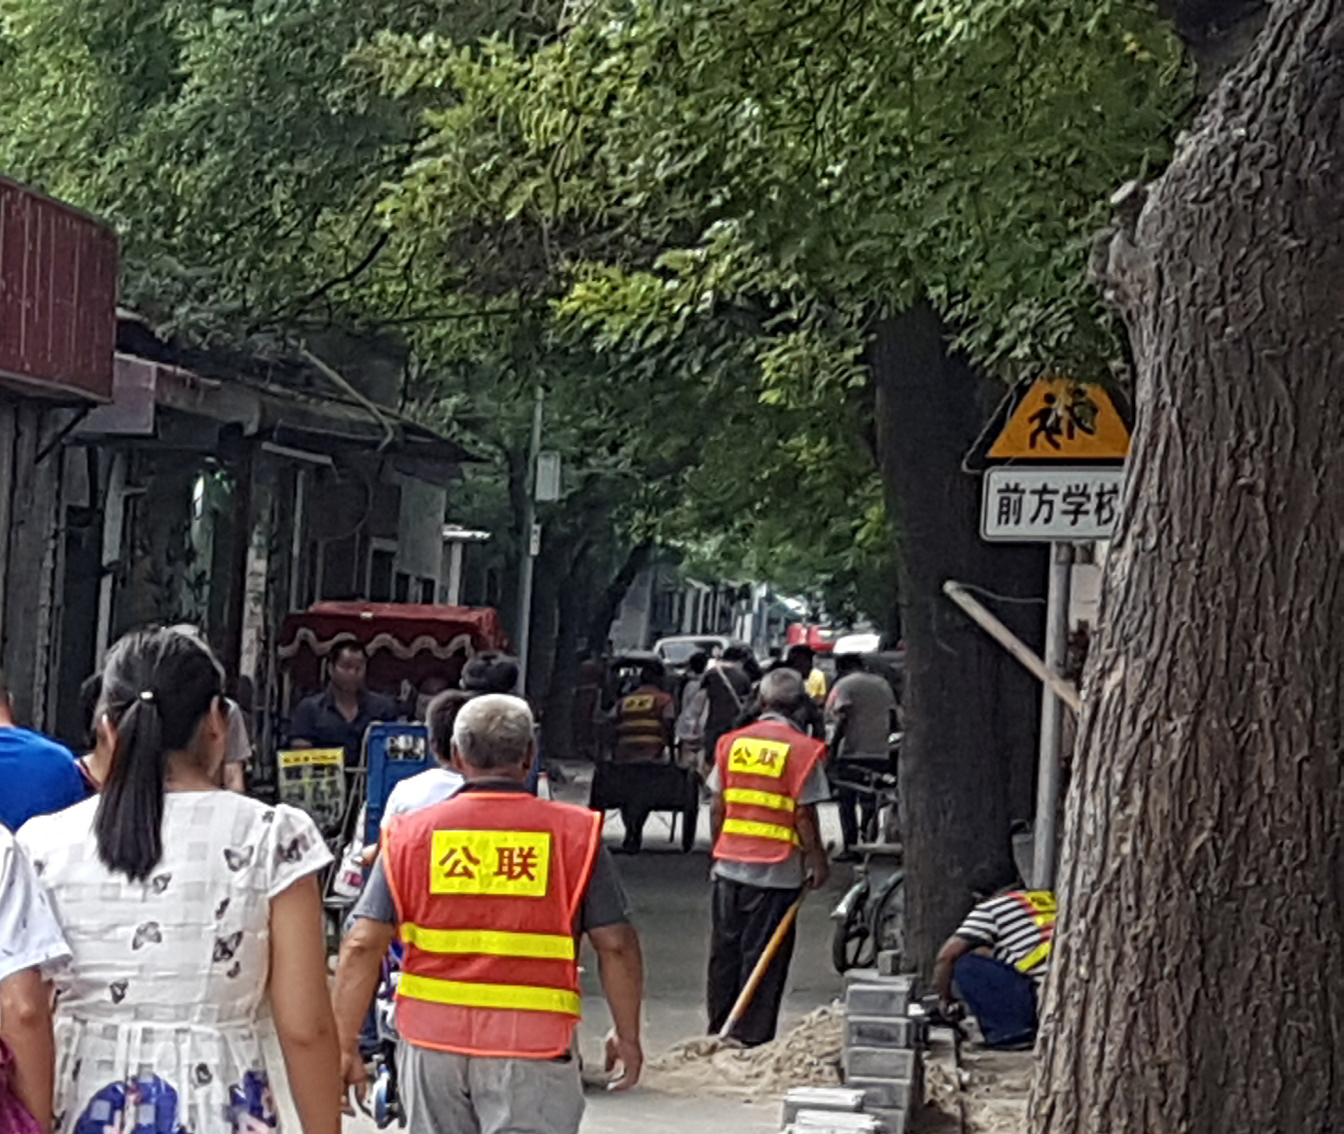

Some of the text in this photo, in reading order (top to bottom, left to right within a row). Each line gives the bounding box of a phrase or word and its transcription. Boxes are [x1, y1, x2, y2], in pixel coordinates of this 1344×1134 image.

[996, 483, 1119, 526] 前方学校
[438, 846, 538, 881] 公联
